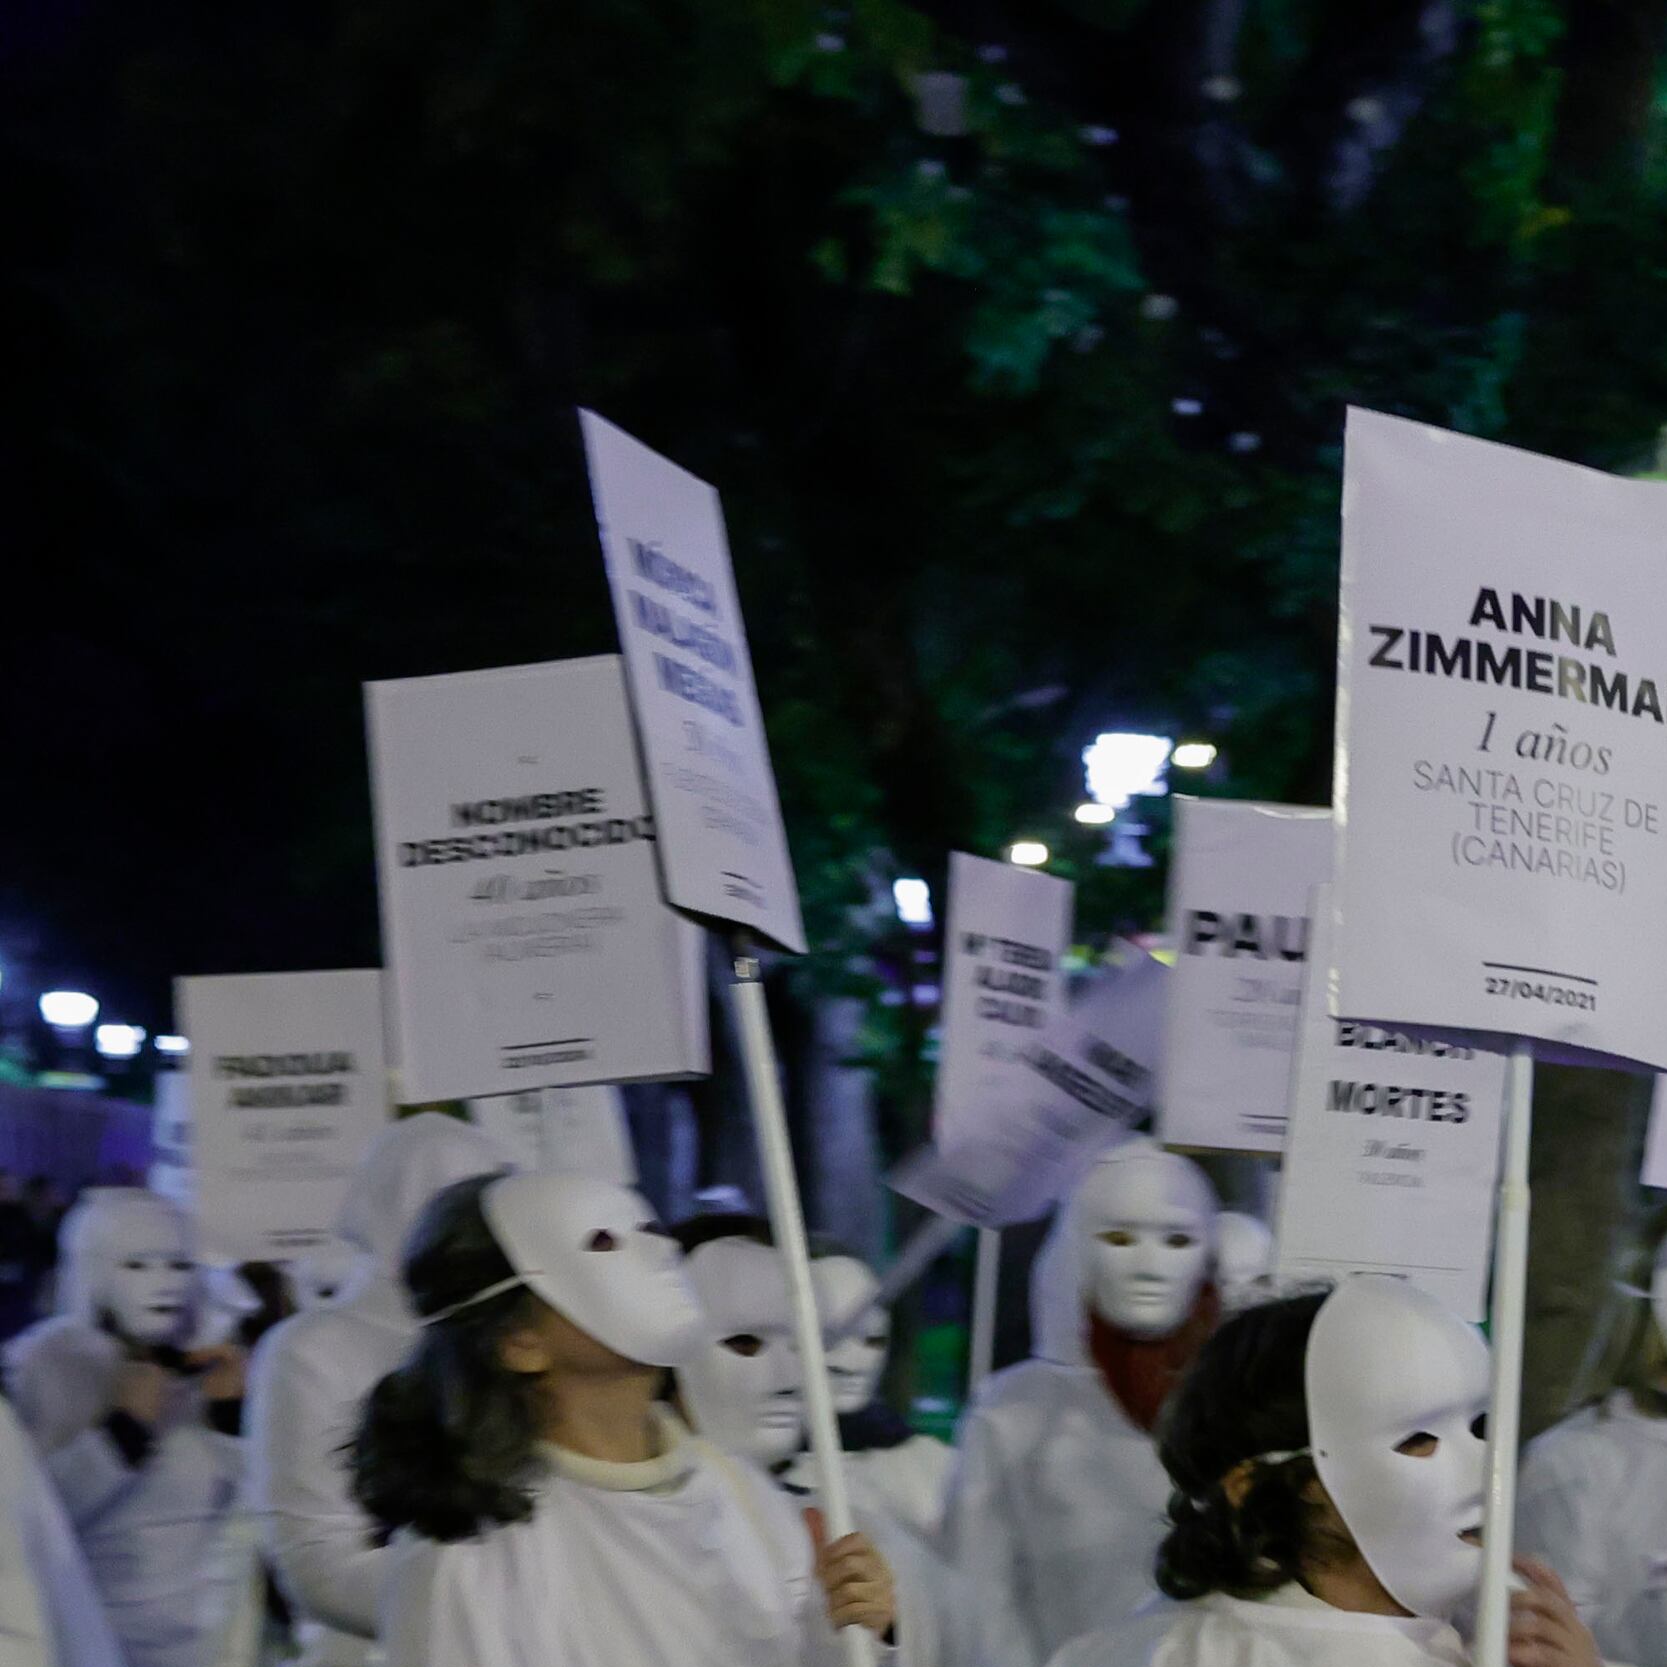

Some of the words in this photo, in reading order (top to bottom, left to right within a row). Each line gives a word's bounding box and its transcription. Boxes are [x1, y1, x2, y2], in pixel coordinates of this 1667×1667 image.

[1469, 586, 1617, 657] ANNA
[1477, 710, 1498, 752] 1
[1516, 722, 1612, 776] años
[1413, 759, 1523, 802] SANTA
[1533, 778, 1614, 823] CRUZ
[1624, 800, 1659, 834] DE
[1468, 801, 1614, 856] TENERIFE
[1451, 832, 1627, 895] (CANARIAS)
[1484, 977, 1597, 1011] 27/04/2021
[1326, 1080, 1472, 1124] MORTES
